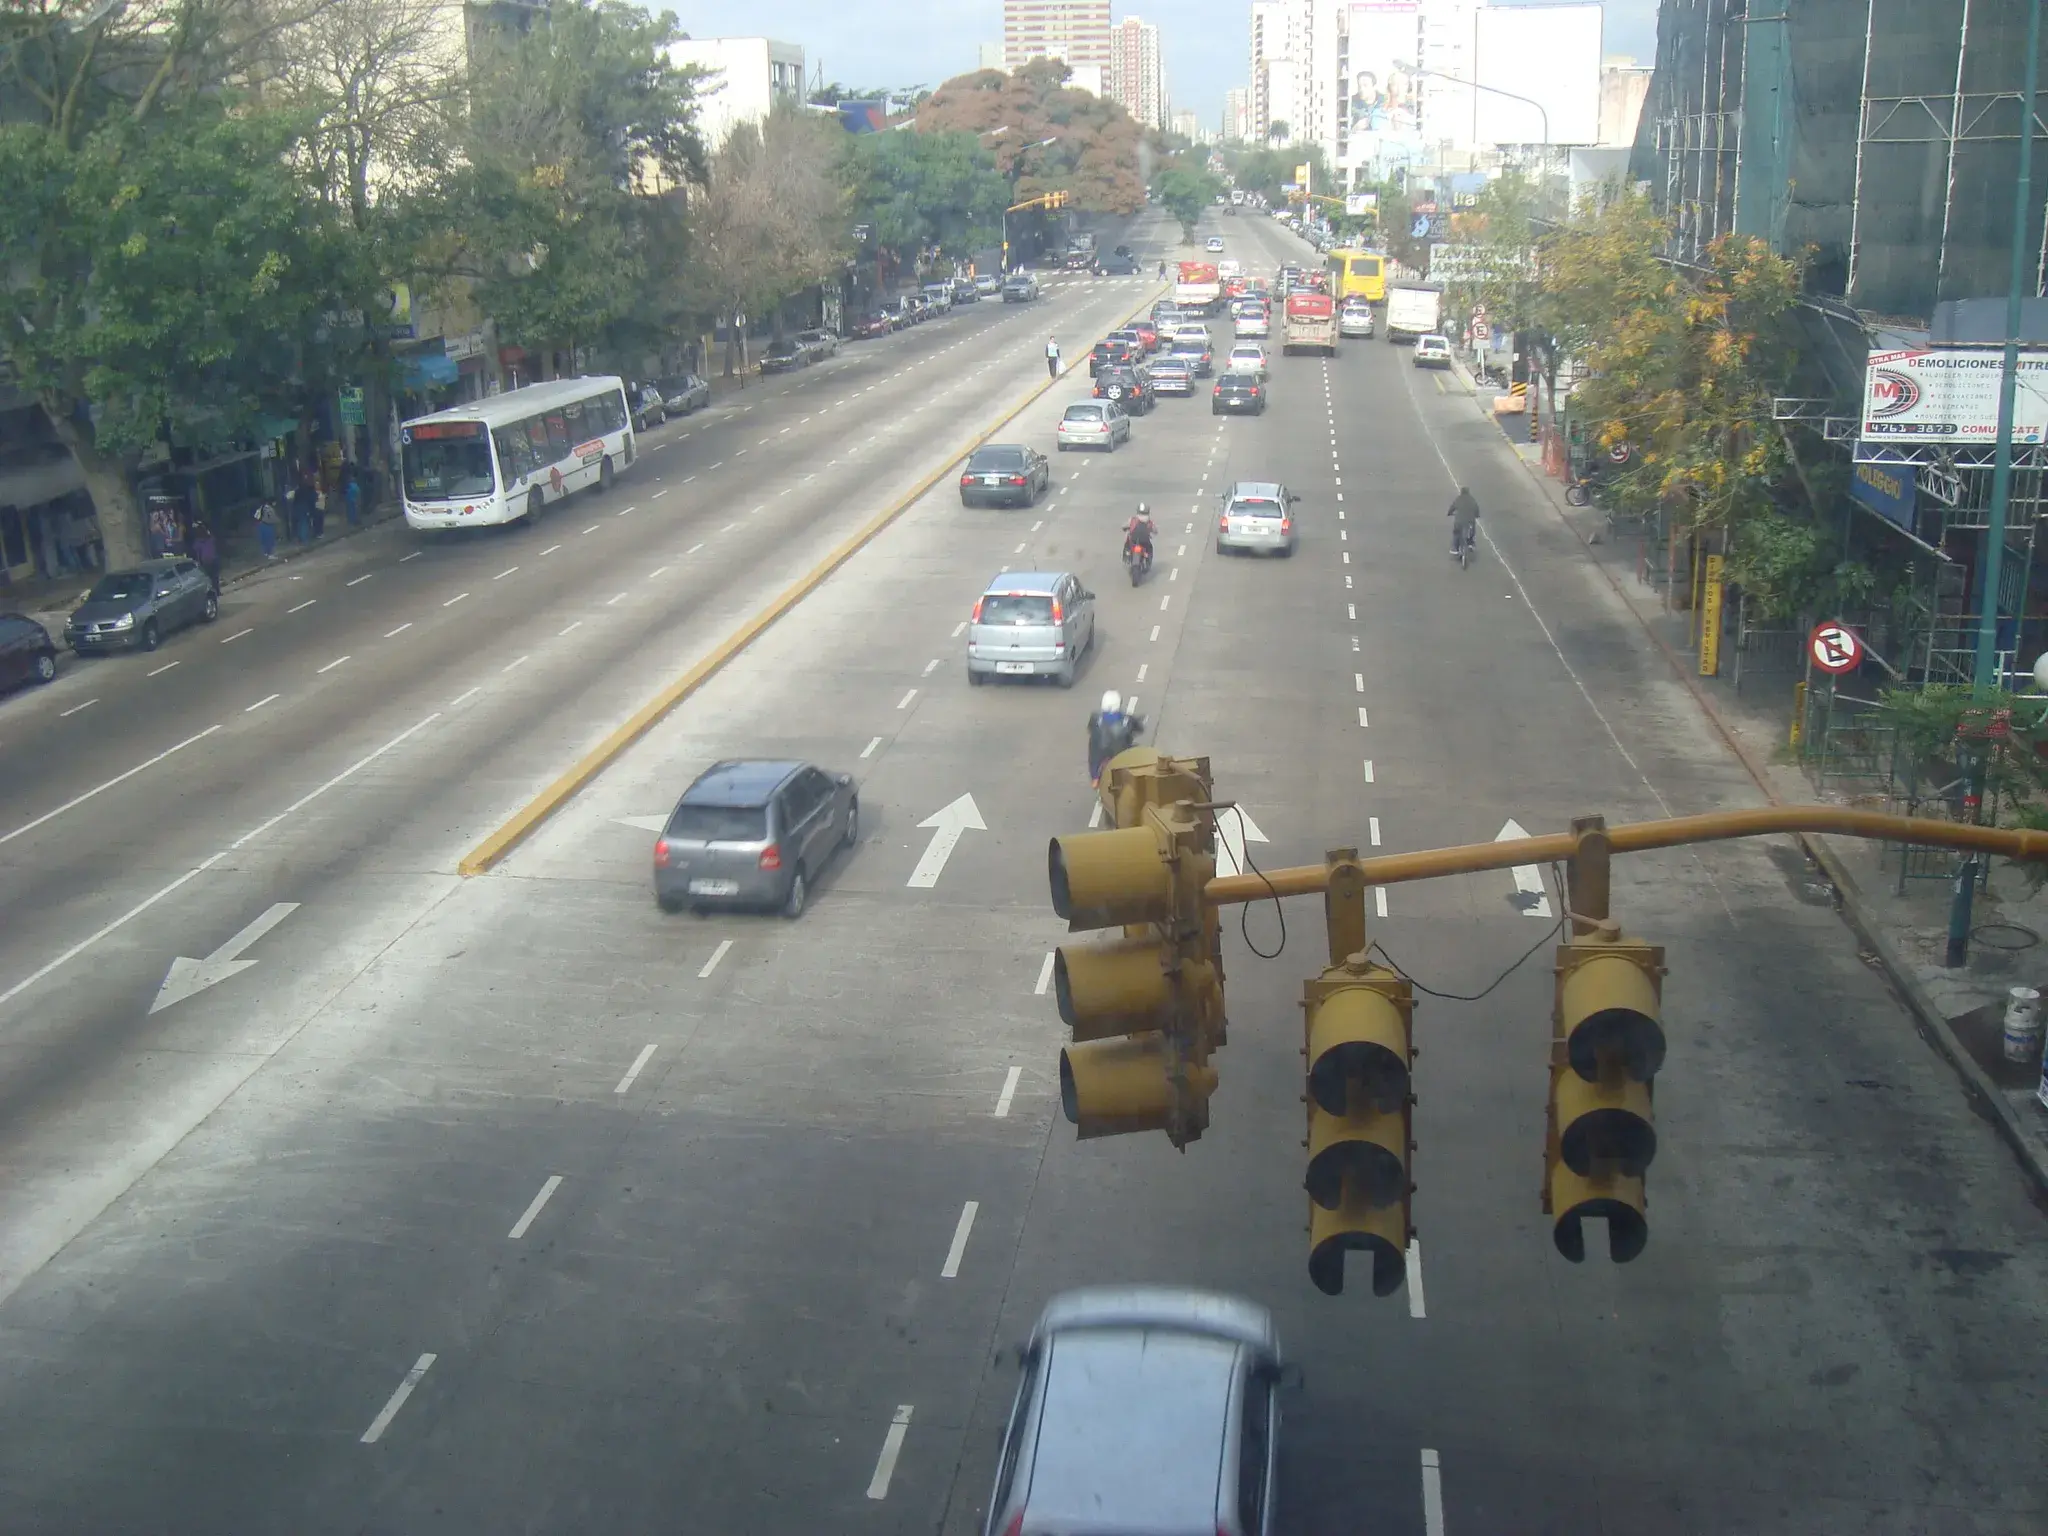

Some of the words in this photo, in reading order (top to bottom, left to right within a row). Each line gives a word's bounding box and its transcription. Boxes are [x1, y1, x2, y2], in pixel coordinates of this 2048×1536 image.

[1869, 356, 1890, 365] OTRA
[1891, 352, 1906, 361] MAS
[1909, 358, 2004, 370] DEMOLICIONES
[1961, 425, 2040, 434] COMUCATE
